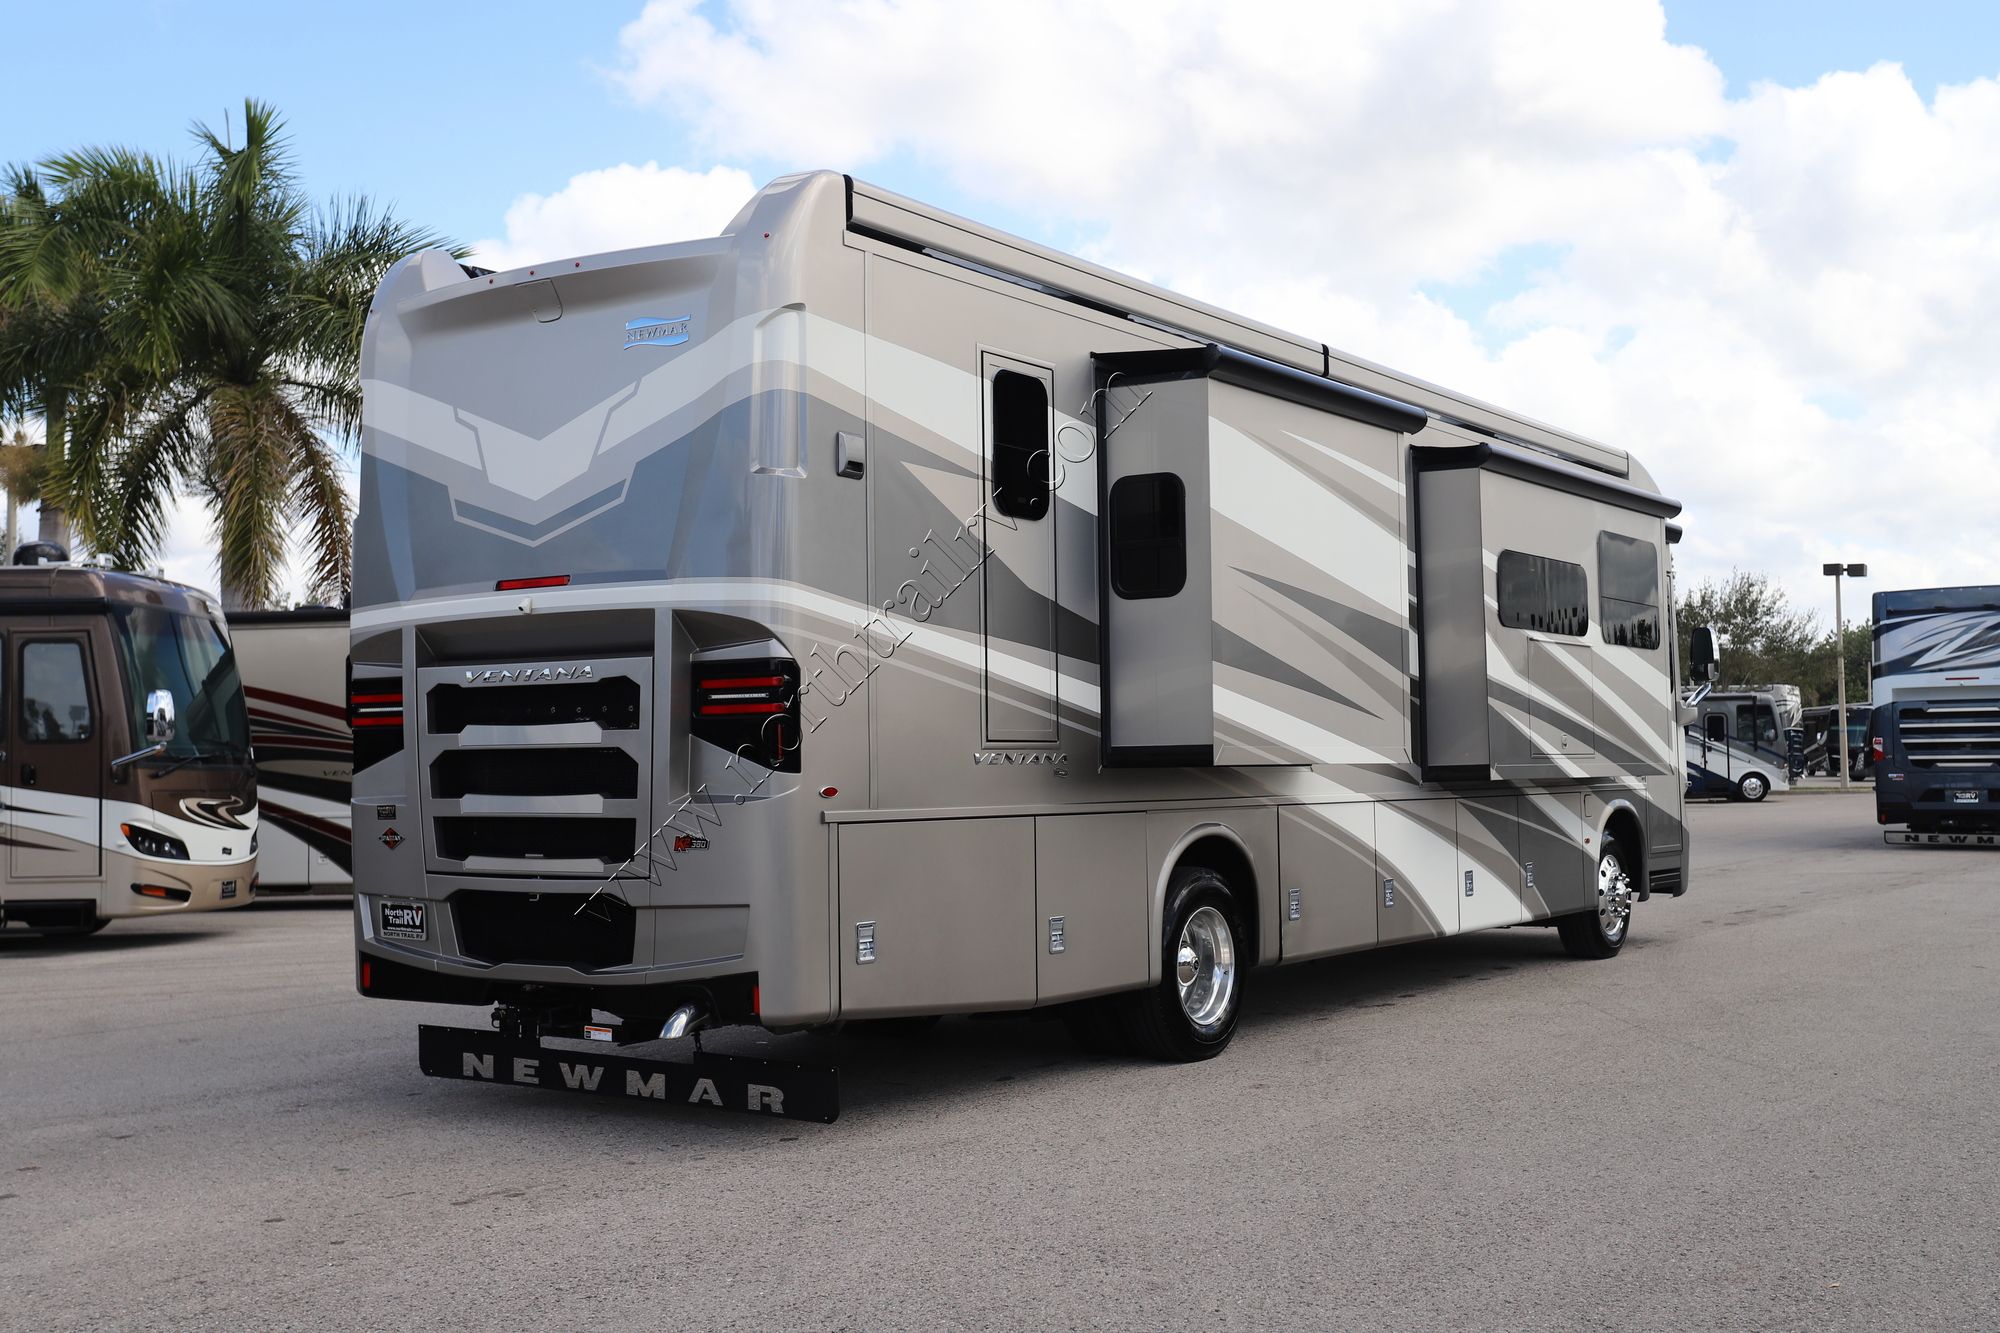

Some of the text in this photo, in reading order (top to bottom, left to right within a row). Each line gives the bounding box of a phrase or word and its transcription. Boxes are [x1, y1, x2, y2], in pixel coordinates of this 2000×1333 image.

[626, 322, 688, 342] NEWMAR
[465, 665, 593, 684] VENTANA
[973, 752, 1068, 766] VENTANA
[384, 907, 423, 926] North RV
[388, 916, 404, 925] Trail
[462, 1052, 785, 1114] NEWMAR
